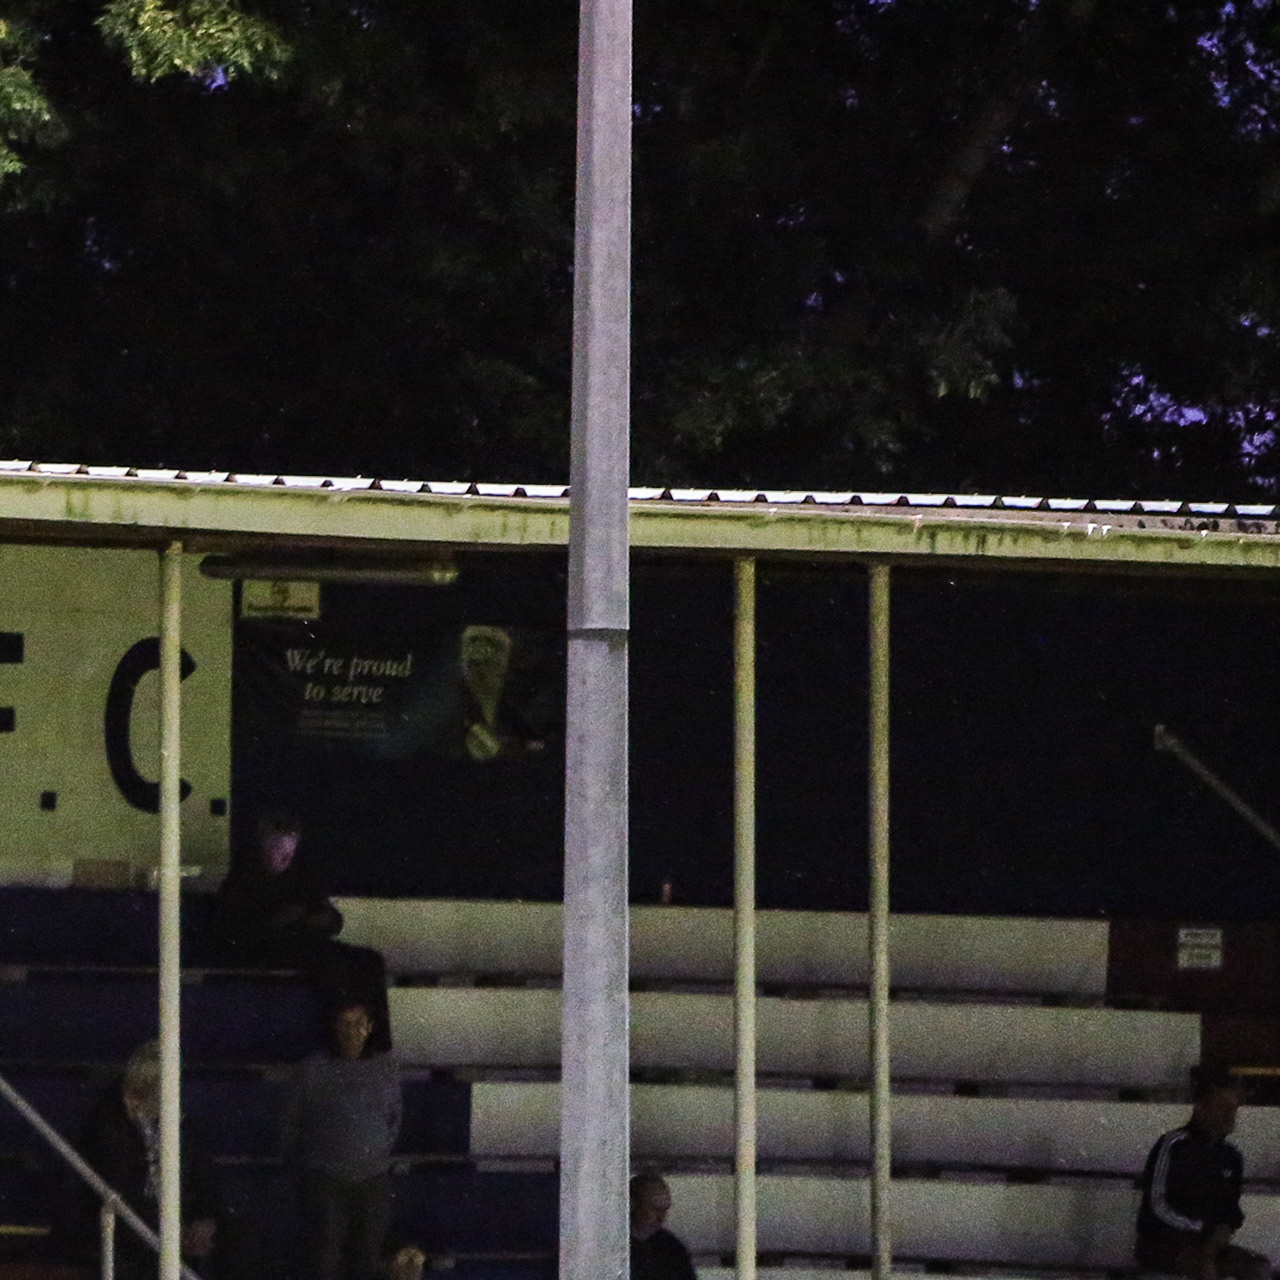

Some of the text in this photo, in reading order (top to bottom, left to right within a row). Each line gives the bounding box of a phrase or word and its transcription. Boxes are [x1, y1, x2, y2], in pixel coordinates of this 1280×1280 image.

[285, 648, 413, 683] We're proud
[304, 682, 384, 705] to serve
